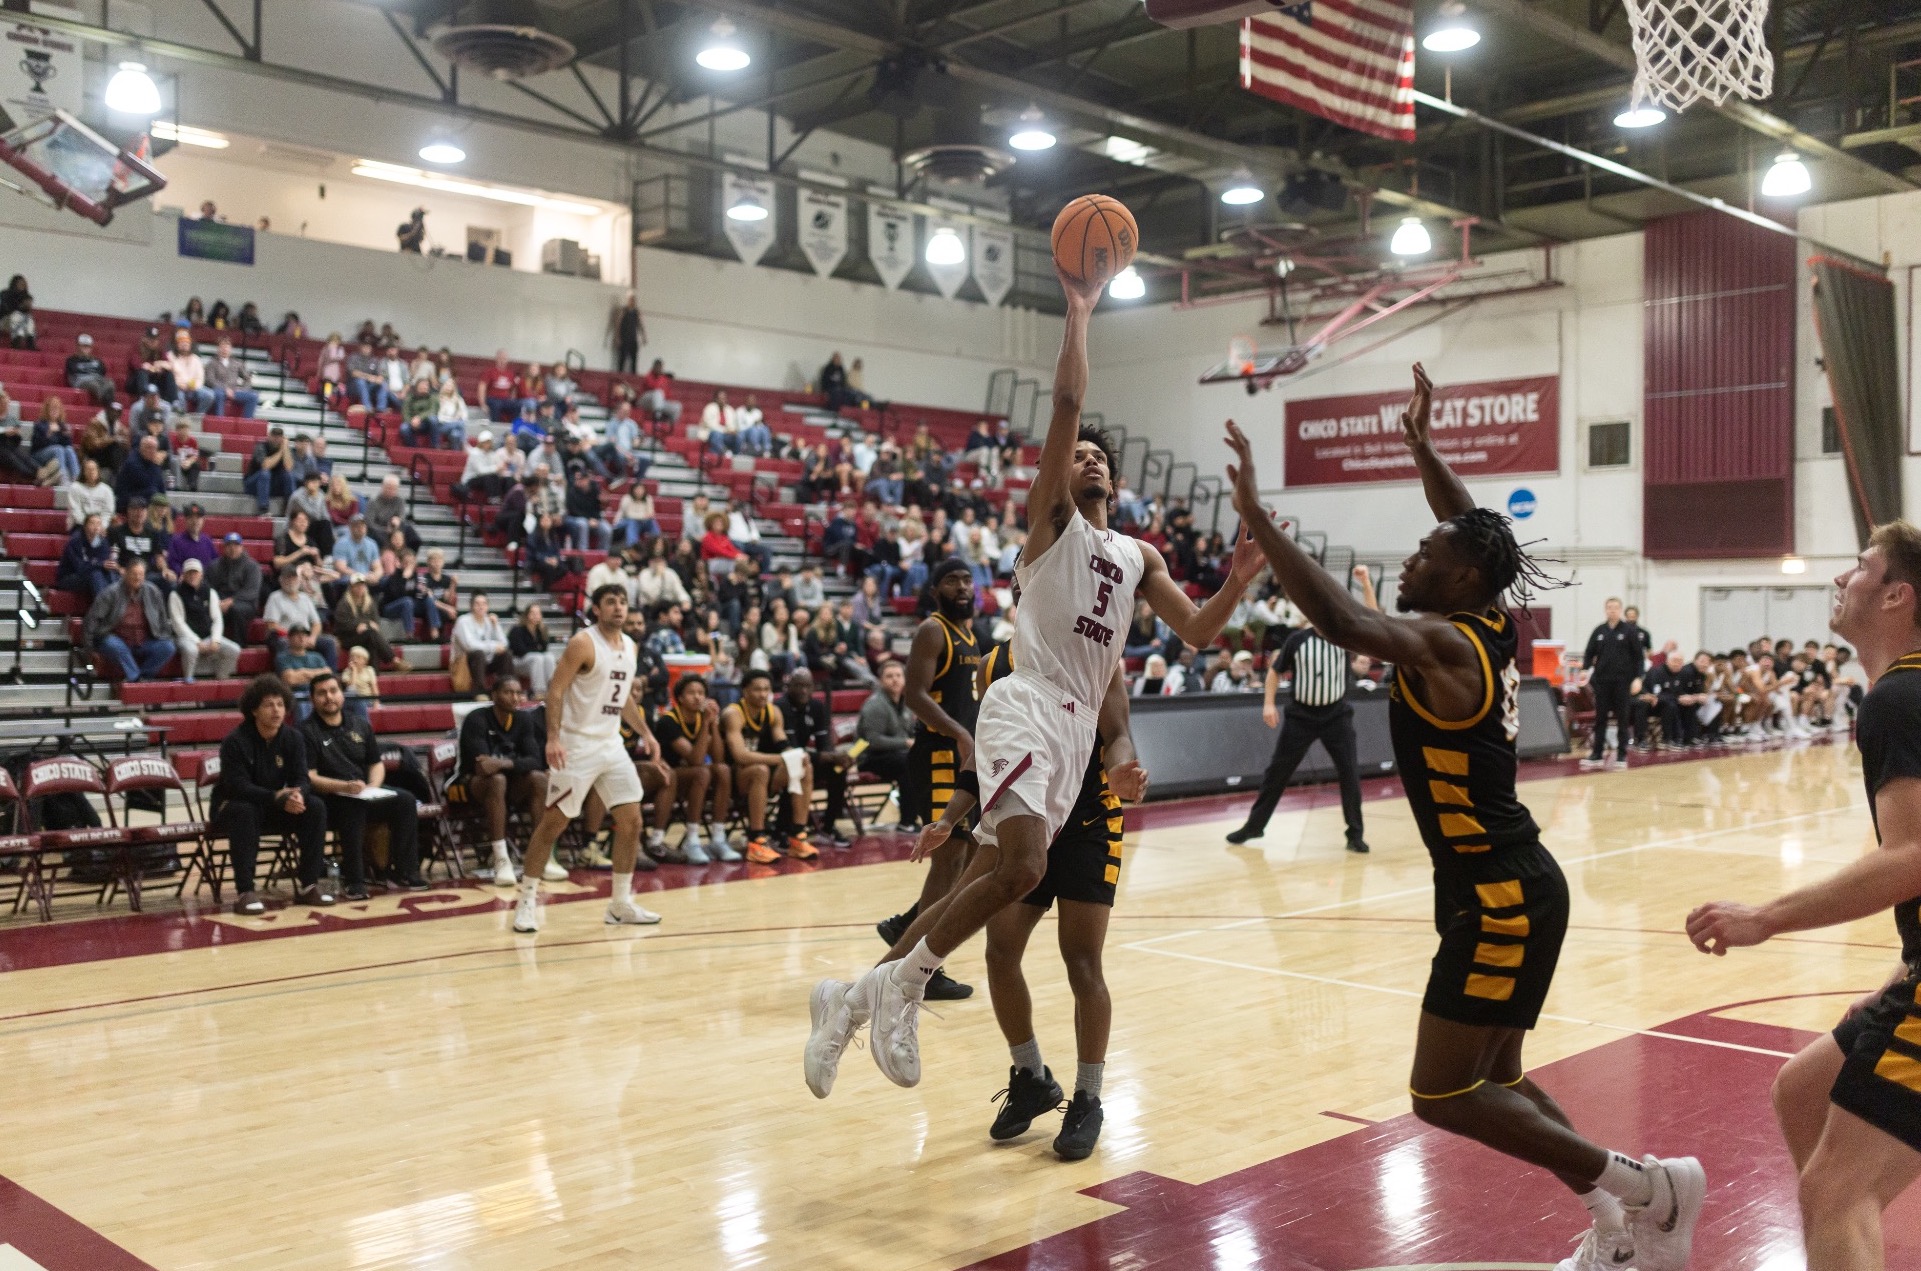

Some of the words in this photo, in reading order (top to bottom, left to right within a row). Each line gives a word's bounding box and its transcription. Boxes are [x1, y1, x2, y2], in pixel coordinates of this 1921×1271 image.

[1299, 418, 1338, 440] CHICO
[1340, 414, 1379, 437] STATE
[1465, 392, 1540, 428] STORE
[1092, 580, 1114, 618] 5
[1073, 615, 1115, 647] STATE
[611, 684, 621, 702] 2
[31, 763, 60, 785] CHICO
[61, 763, 93, 782] STATE
[114, 760, 141, 782] CHICO
[141, 759, 173, 779] STATE
